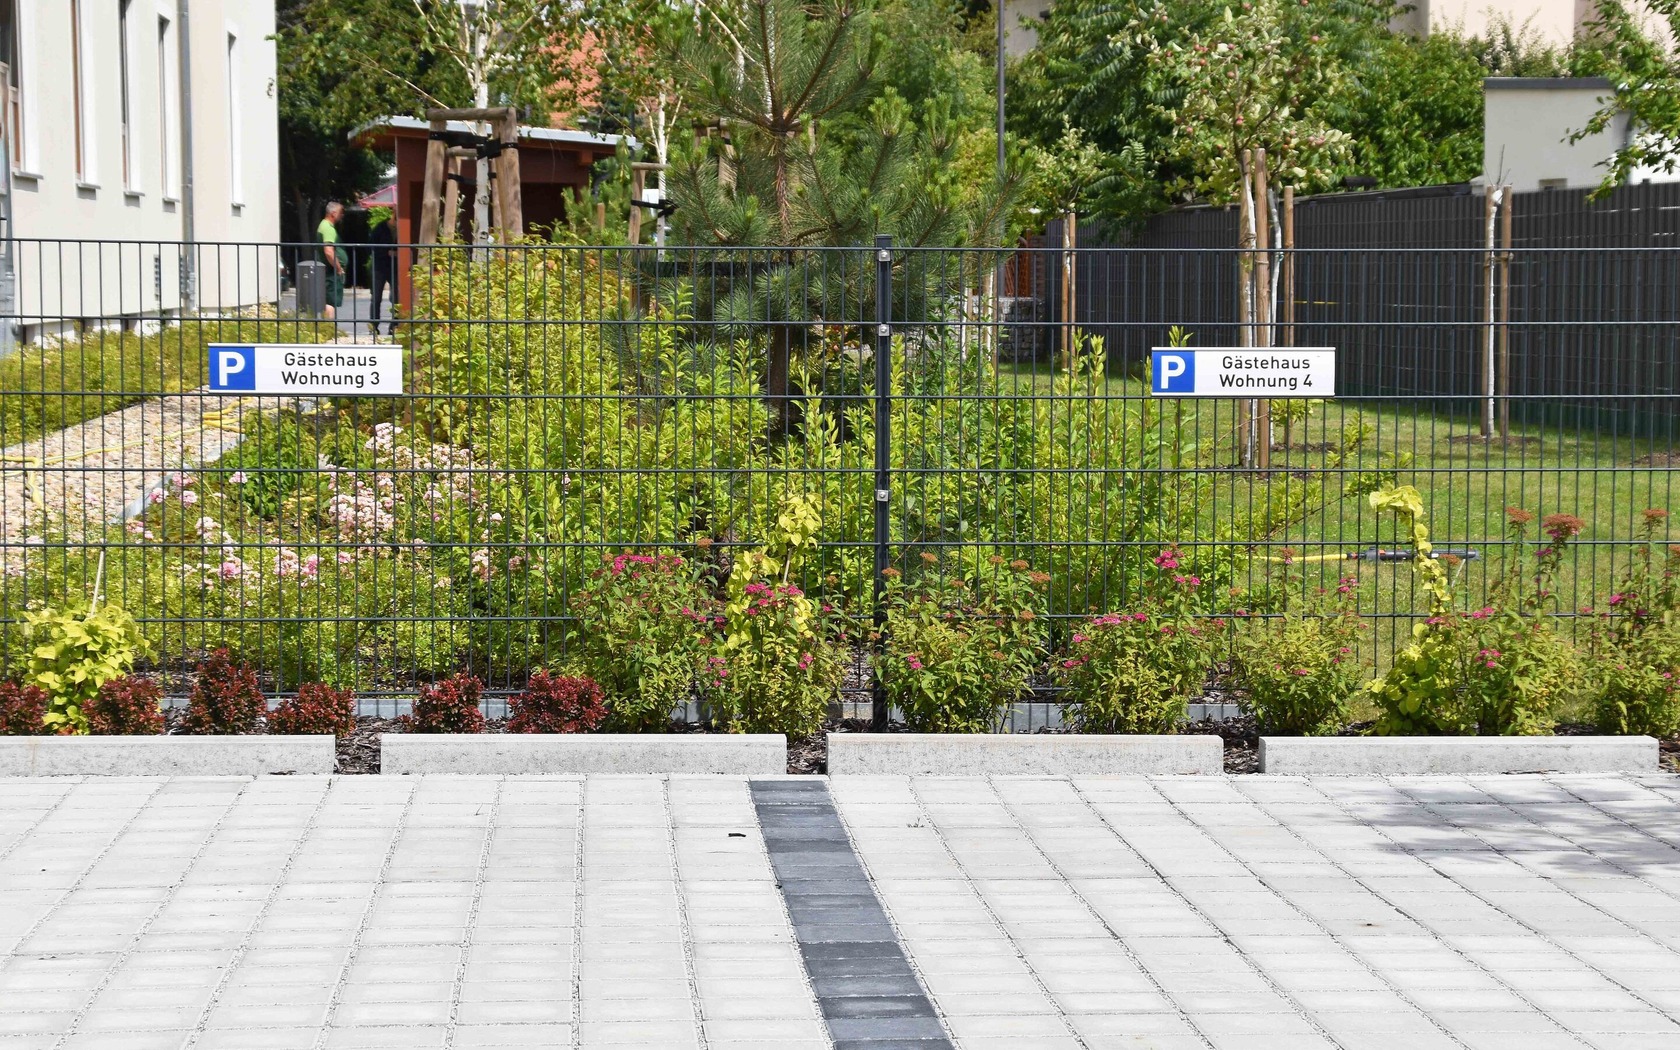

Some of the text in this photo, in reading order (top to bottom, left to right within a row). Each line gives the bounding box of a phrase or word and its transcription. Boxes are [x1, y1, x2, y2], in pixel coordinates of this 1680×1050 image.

[284, 352, 378, 367] Gästehaus
[1222, 356, 1311, 370] Gästehaus
[218, 351, 246, 386] P
[1160, 355, 1186, 390] P
[281, 371, 380, 389] Wohnung 3
[1219, 374, 1313, 391] Wohnung 4
